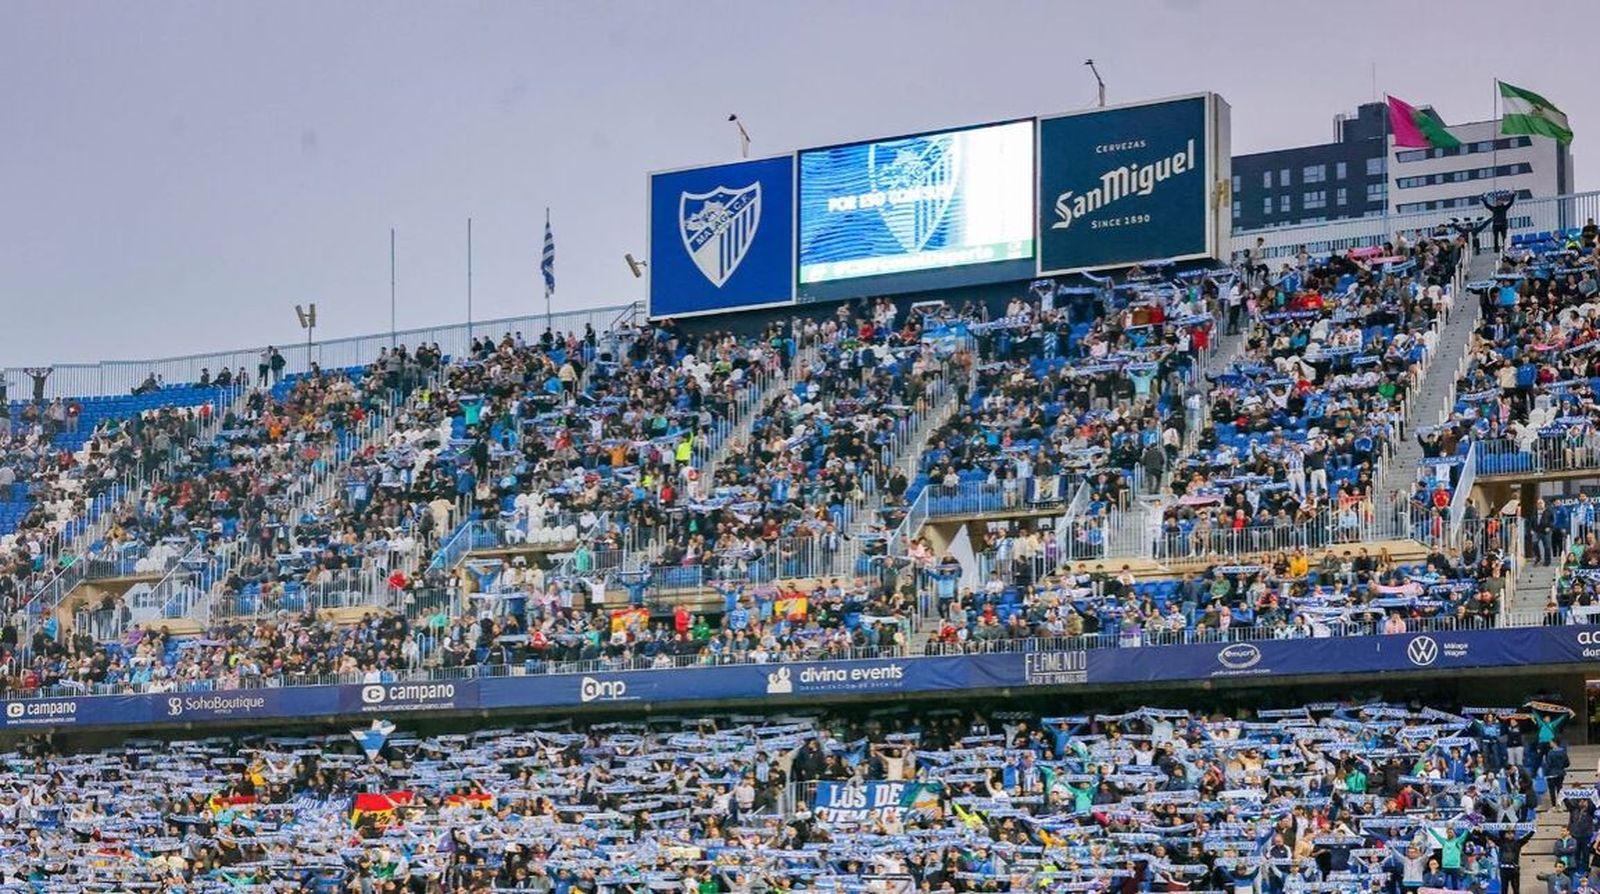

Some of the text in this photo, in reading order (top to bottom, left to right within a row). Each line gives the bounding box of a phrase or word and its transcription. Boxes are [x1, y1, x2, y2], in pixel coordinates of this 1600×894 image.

[1096, 140, 1146, 153] CERVEZAS
[1091, 214, 1151, 229] SINCE 1890
[800, 663, 903, 683] divina events
[389, 684, 455, 703] campano
[26, 701, 77, 717] campano
[185, 695, 265, 712] SohoBoutique
[829, 784, 905, 808] LOS DE
